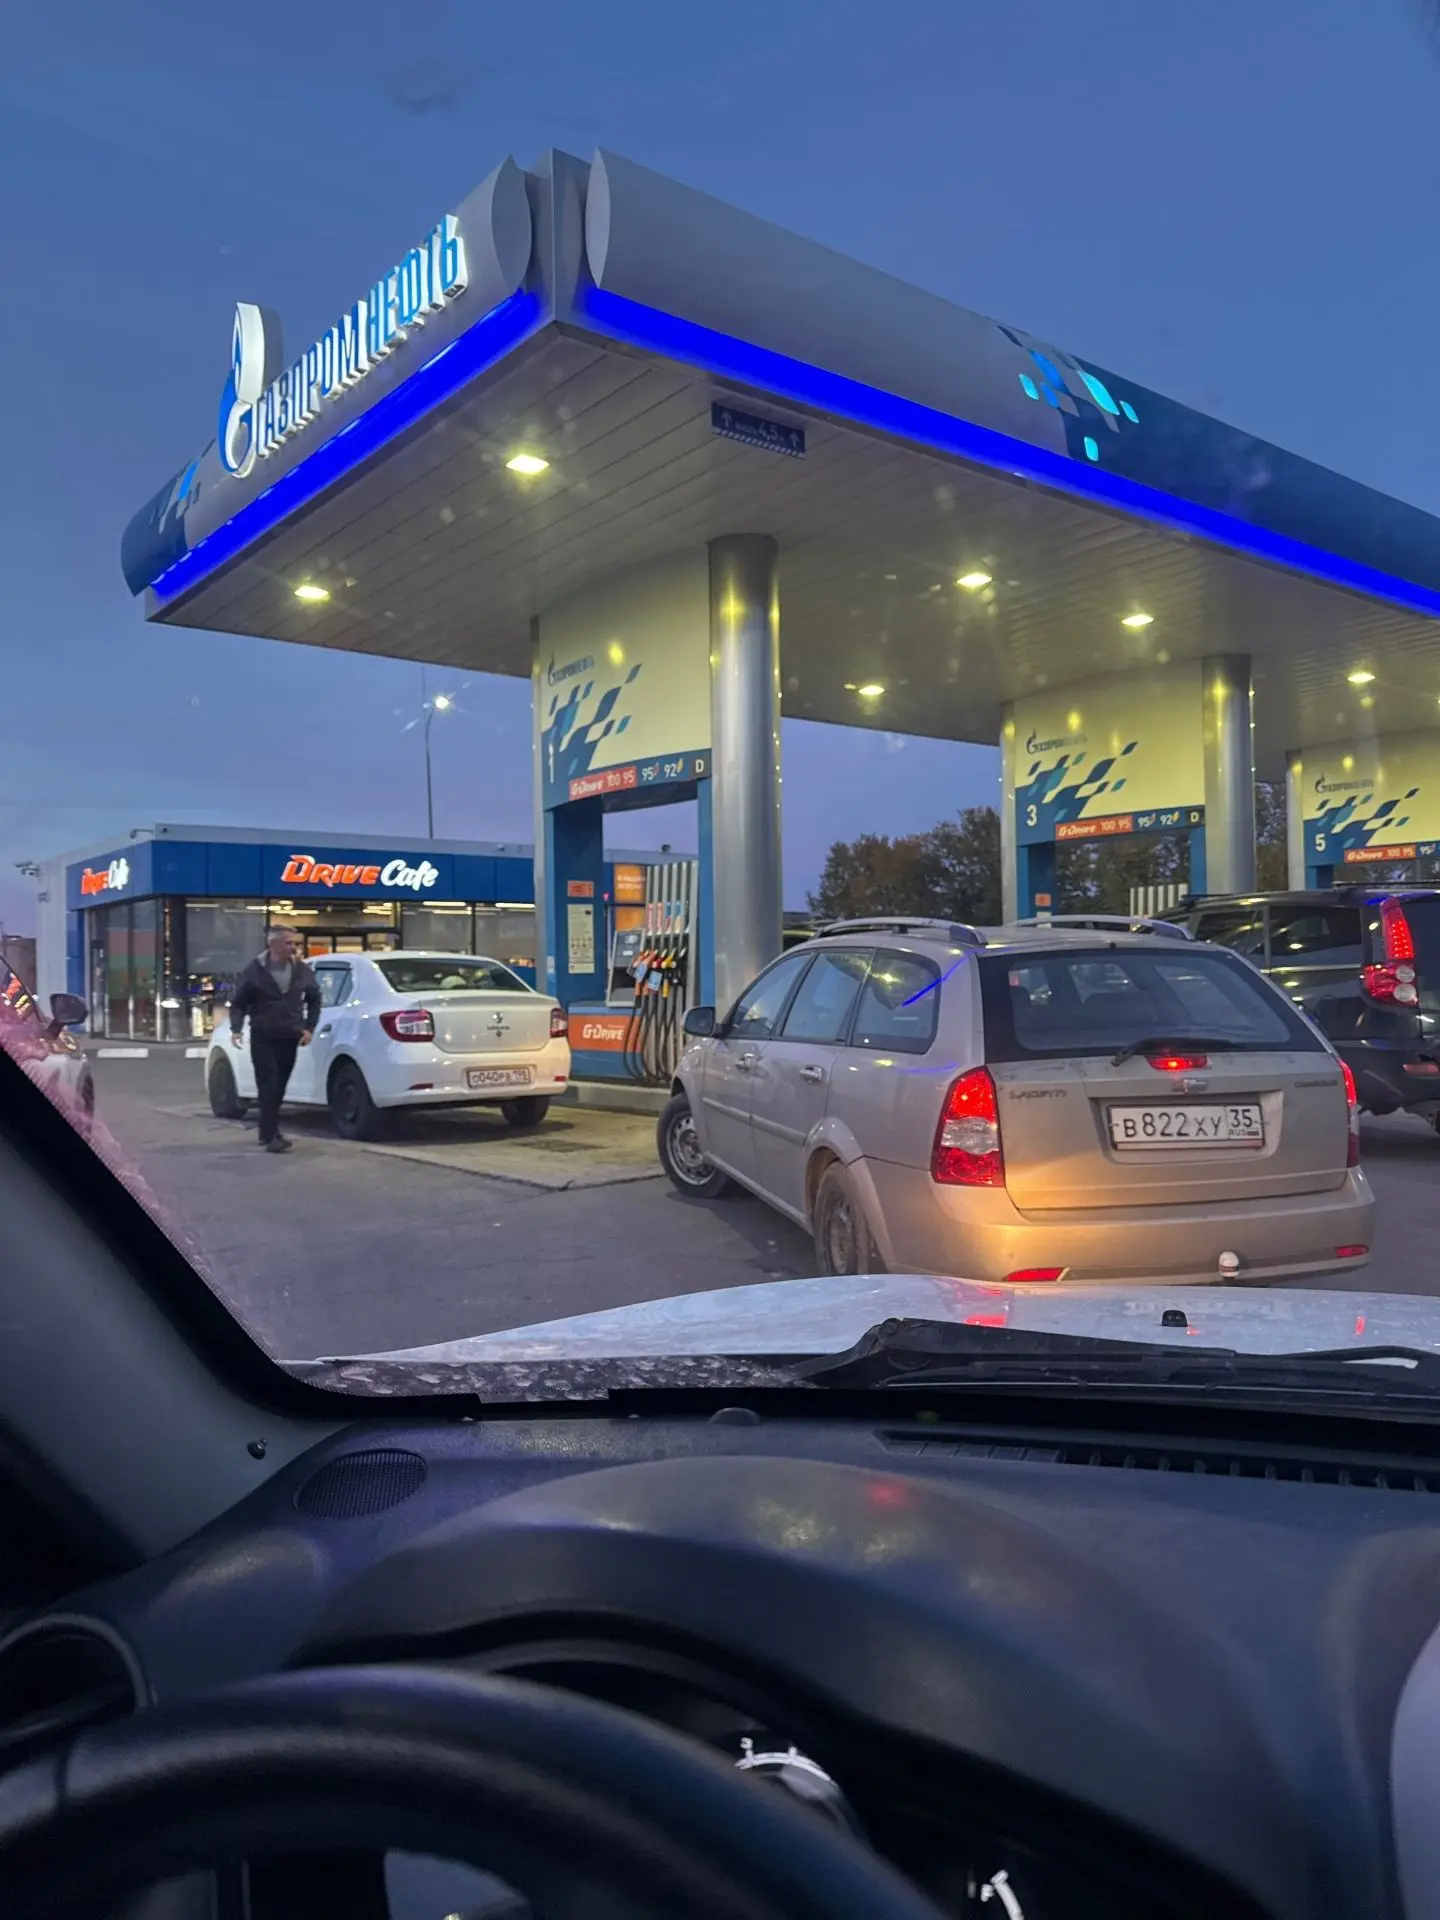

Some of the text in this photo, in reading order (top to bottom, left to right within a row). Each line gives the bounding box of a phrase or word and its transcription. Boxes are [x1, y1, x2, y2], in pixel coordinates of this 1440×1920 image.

[695, 759, 704, 773] D
[1027, 805, 1037, 826] 3
[1315, 833, 1326, 852] 5
